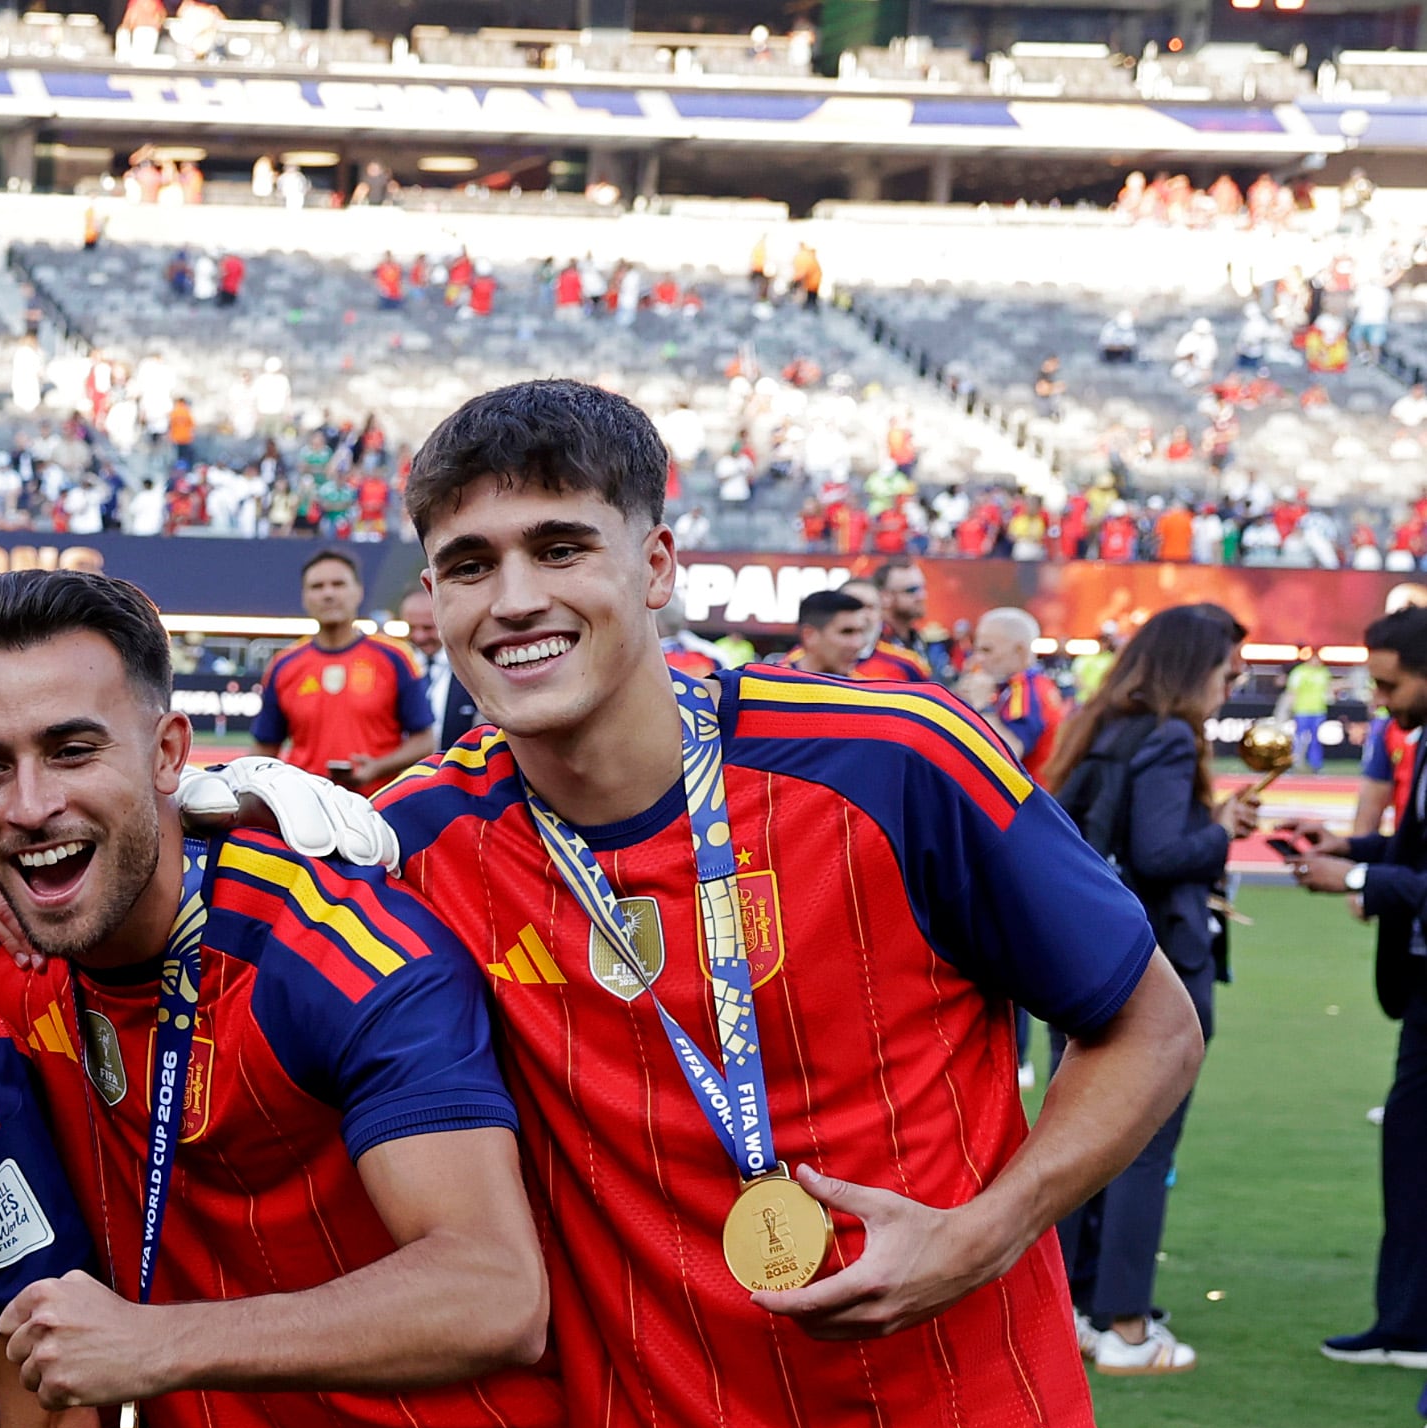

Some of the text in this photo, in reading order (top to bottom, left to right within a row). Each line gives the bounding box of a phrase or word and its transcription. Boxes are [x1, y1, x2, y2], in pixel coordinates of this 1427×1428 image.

[677, 1038, 707, 1079] FIFA
[157, 1050, 179, 1123] 2026
[737, 1083, 759, 1131] FIFA
[152, 1124, 169, 1167] CUP
[144, 1168, 162, 1242] WORLD
[765, 1262, 799, 1280] 2026
[769, 1244, 785, 1255] FIFA
